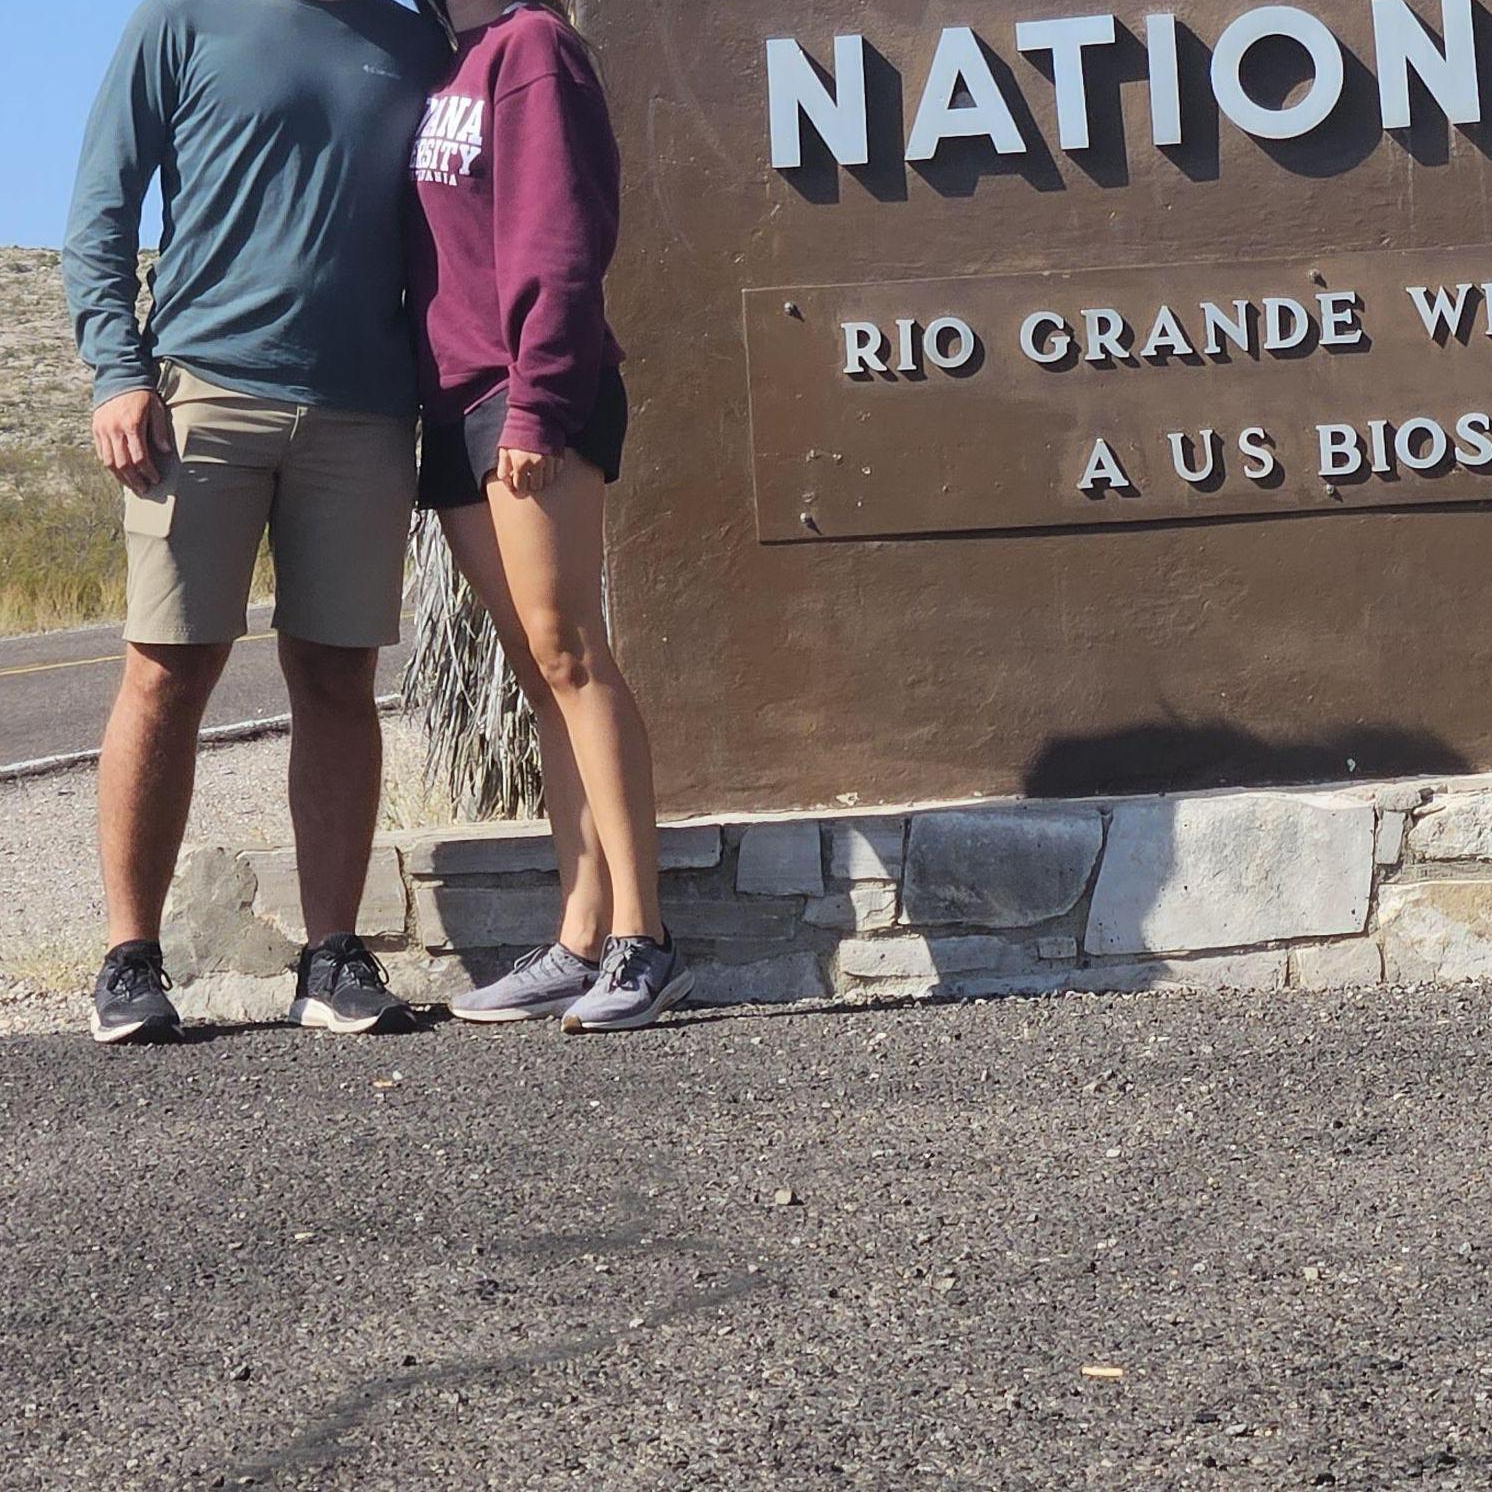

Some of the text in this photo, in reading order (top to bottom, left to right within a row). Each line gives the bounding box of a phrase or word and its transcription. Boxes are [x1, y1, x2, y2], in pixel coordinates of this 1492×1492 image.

[839, 315, 975, 375] RIO
[1019, 289, 1363, 364] GRANDE
[1075, 437, 1130, 490] A
